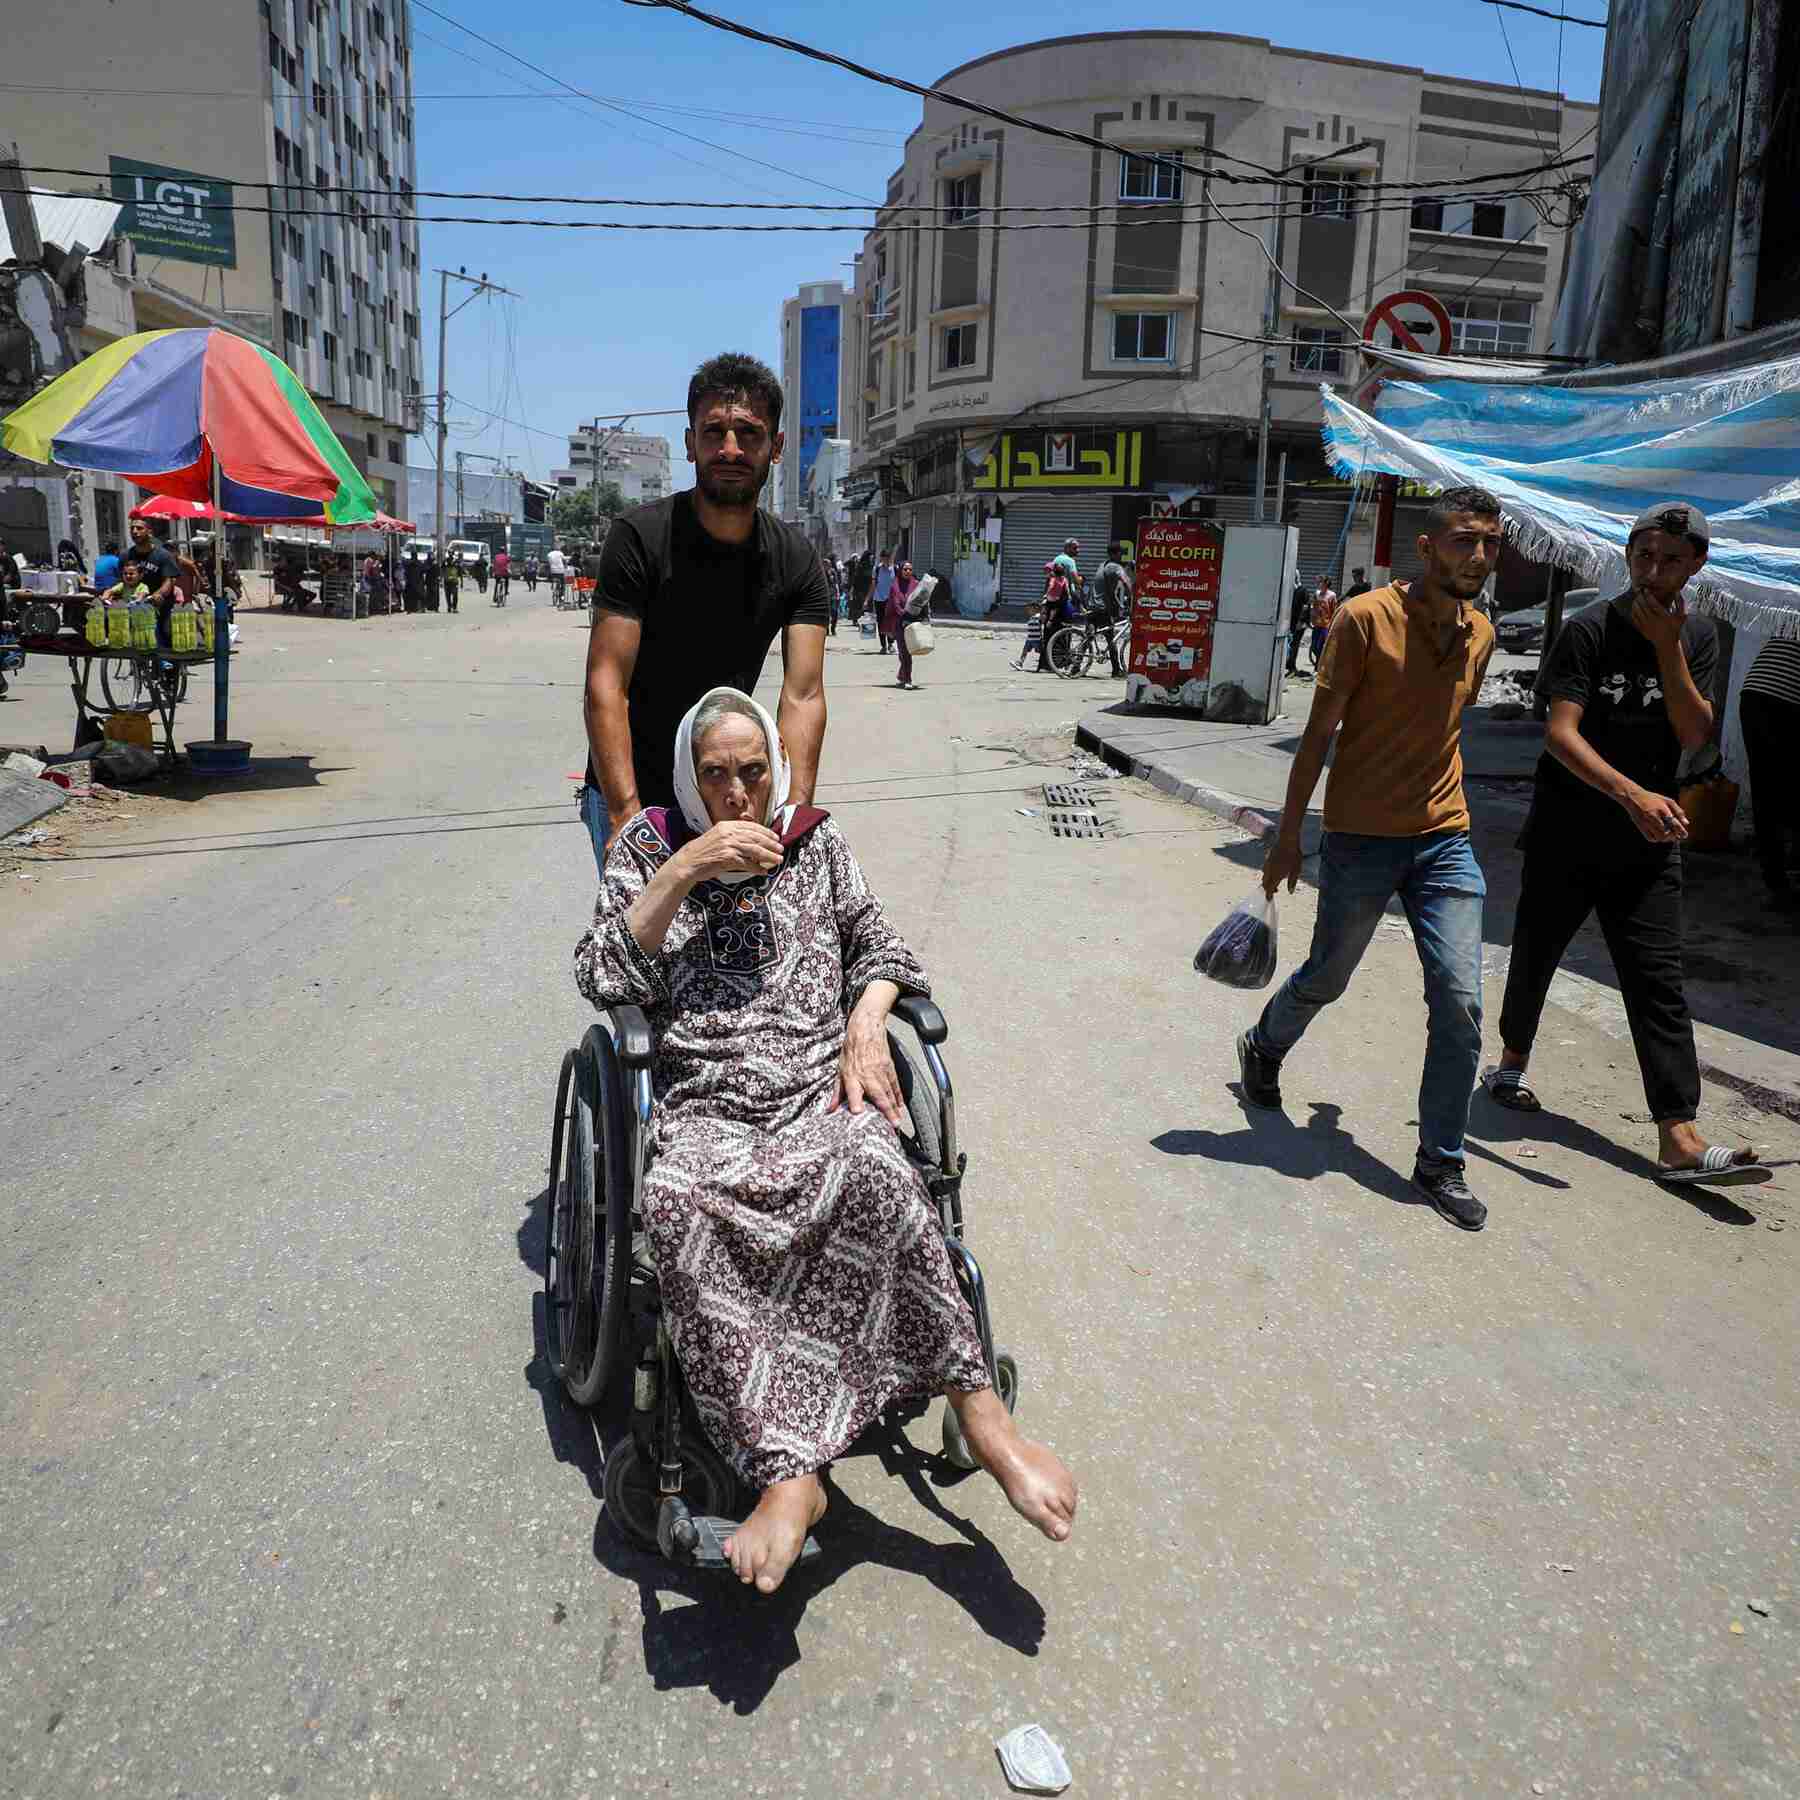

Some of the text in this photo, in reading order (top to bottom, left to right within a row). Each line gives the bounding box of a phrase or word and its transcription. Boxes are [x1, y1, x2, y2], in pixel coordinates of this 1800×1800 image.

[135, 177, 210, 219] LGT
[973, 432, 1142, 488] الحداد
[1141, 545, 1166, 559] ALI
[1169, 546, 1216, 561] COFFI
